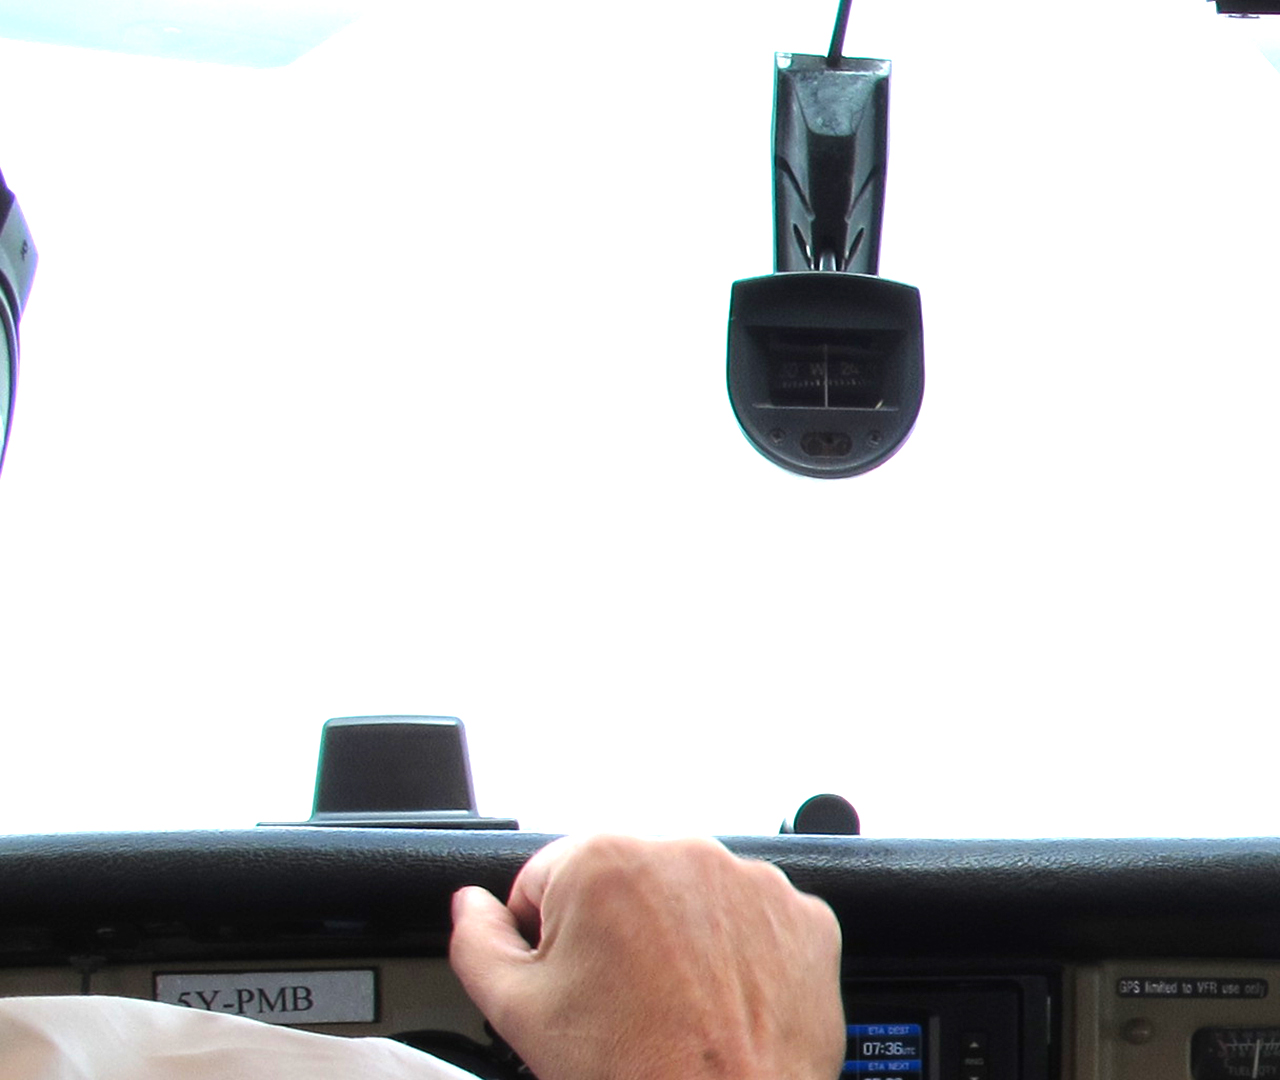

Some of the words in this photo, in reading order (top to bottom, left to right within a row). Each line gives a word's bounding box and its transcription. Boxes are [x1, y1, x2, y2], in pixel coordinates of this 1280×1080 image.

[1120, 980, 1141, 995] GPS
[1145, 980, 1178, 995] limited
[1182, 982, 1193, 995] to
[1197, 981, 1218, 995] VFR
[1222, 984, 1240, 995] use
[1244, 982, 1266, 998] only
[868, 1026, 885, 1035] ETA
[863, 1042, 903, 1056] 07:36
[868, 1062, 885, 1071] ETA
[889, 1061, 910, 1071] NEXT
